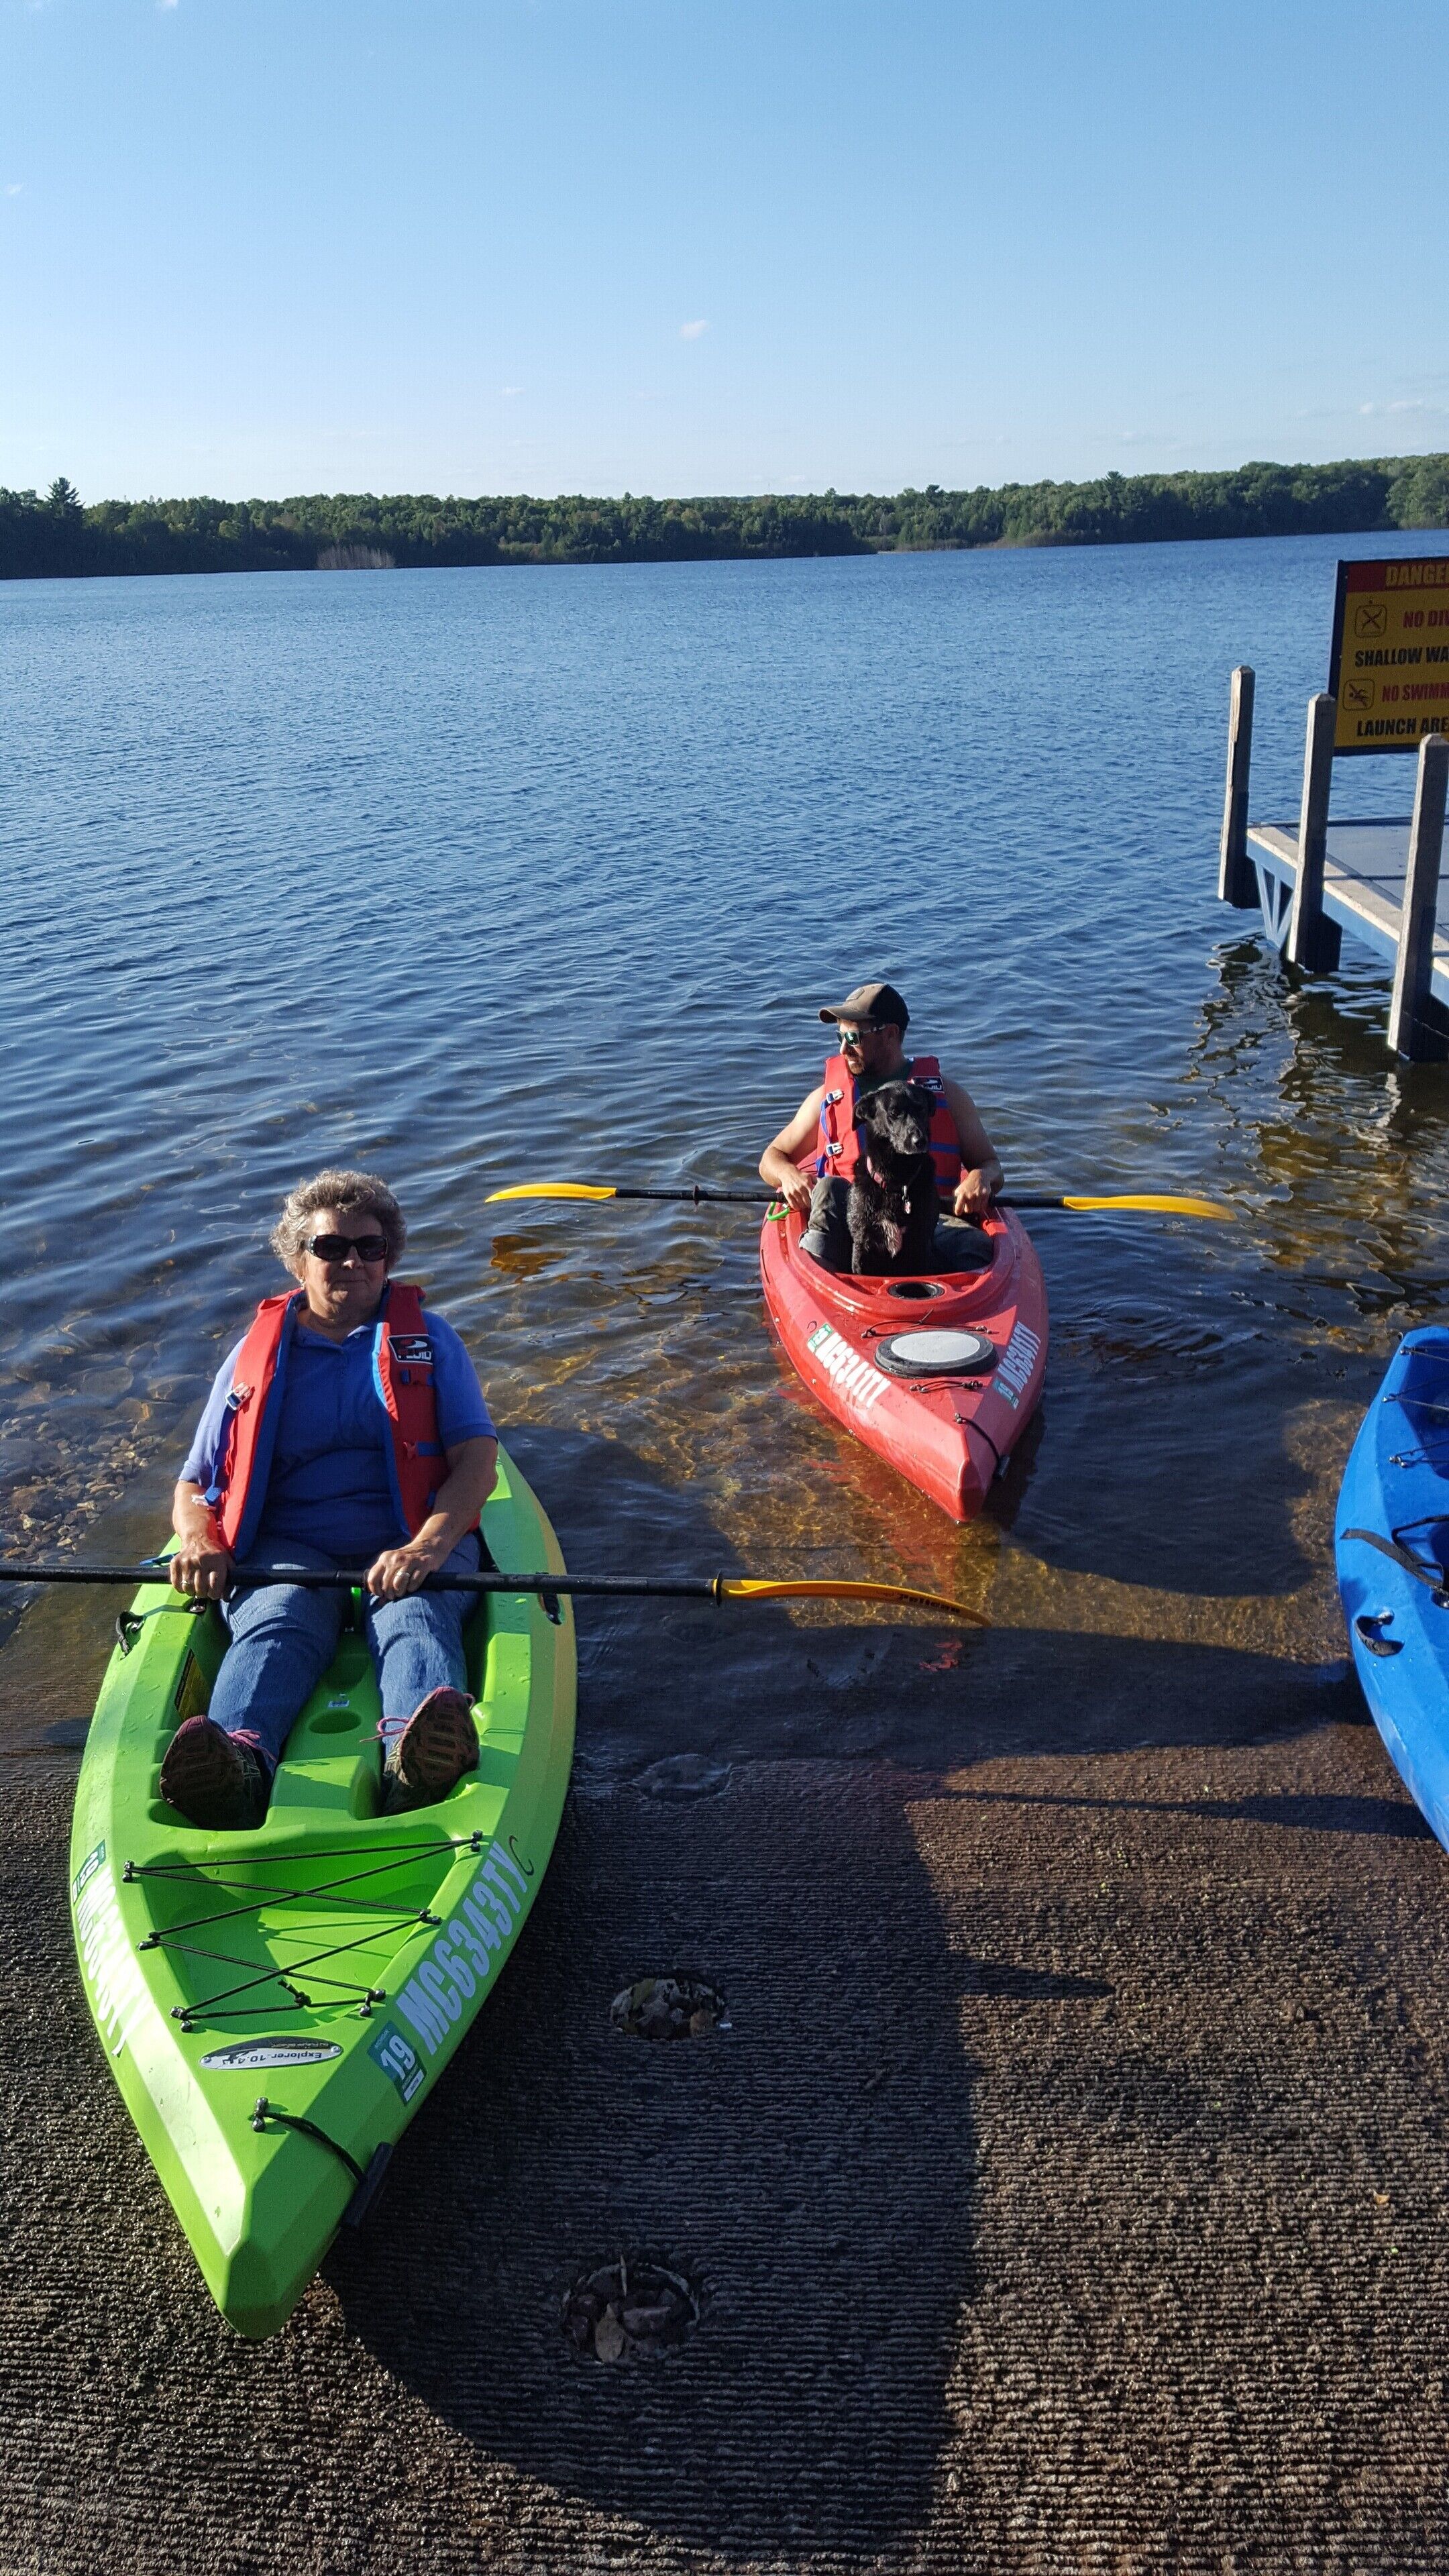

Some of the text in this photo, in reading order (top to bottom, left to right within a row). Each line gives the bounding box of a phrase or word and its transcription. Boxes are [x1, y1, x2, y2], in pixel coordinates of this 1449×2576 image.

[1385, 564, 1449, 586] DANGE
[1403, 610, 1424, 628] NO
[1355, 648, 1422, 667] SHALLOW
[1382, 685, 1399, 702] NO
[1357, 717, 1417, 737] LAUNCH
[396, 1841, 528, 2055] MC6343TY
[237, 2051, 322, 2064] Explorer 10.4
[380, 2035, 416, 2080] 19
